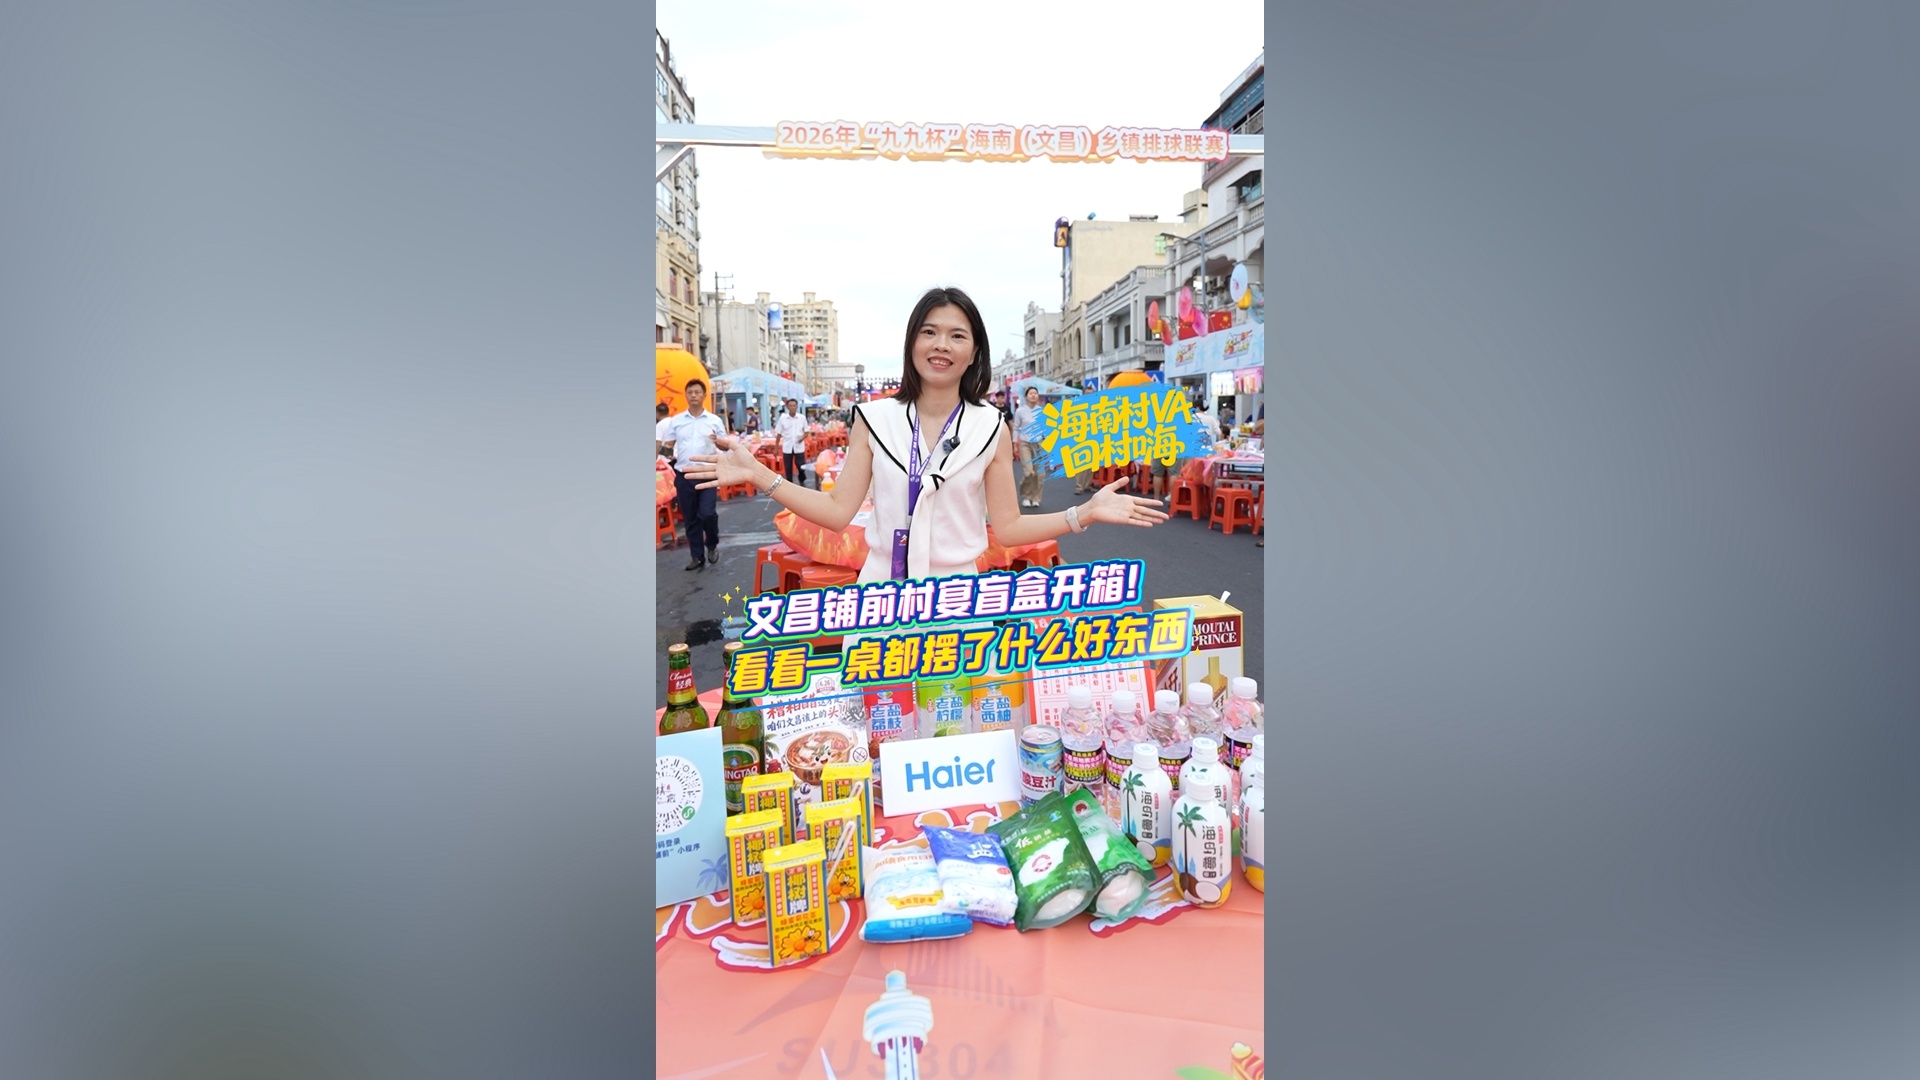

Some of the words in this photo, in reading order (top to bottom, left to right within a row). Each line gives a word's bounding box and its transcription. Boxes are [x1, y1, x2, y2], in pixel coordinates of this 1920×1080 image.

[1192, 620, 1234, 635] MOUTAI
[1191, 632, 1237, 646] PRINCE
[675, 678, 692, 690] 经典
[936, 696, 963, 709] 老盐
[981, 697, 1010, 710] 老盐
[871, 703, 901, 717] 老盐
[981, 709, 1012, 723] 西柚
[871, 717, 902, 730] 荔枝
[905, 755, 996, 792] Haier
[656, 837, 681, 849] 码登录
